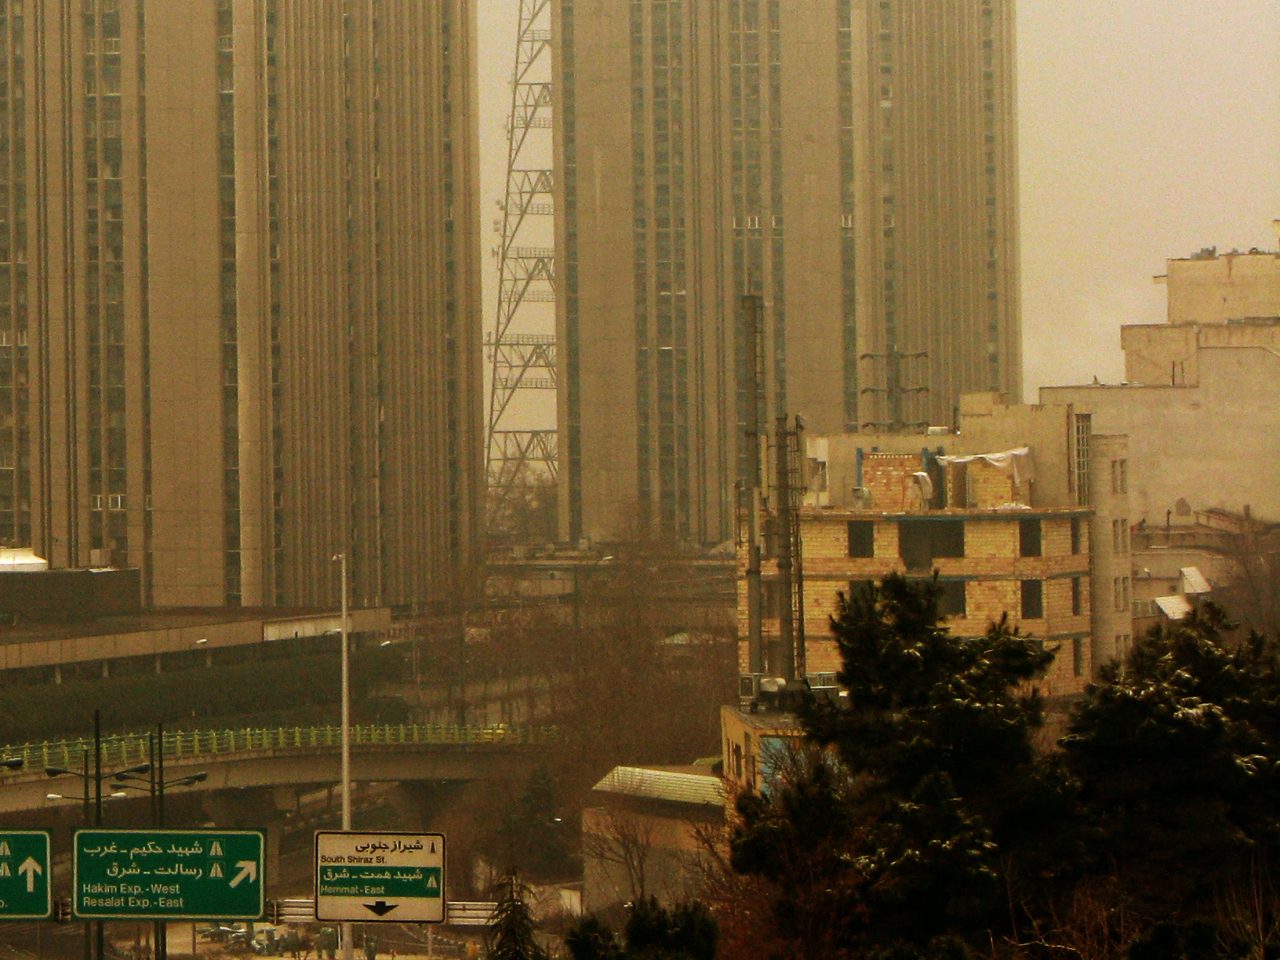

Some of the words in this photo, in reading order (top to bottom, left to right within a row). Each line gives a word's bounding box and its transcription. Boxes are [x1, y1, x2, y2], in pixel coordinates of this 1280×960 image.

[83, 842, 118, 857] غرب
[130, 841, 164, 859] حکیم
[167, 841, 203, 855] شهید
[355, 841, 389, 854] جنوبی
[390, 840, 423, 853] شیراز
[320, 855, 346, 863] South
[347, 855, 374, 864] Shiraz
[106, 862, 140, 878] شرق
[154, 864, 203, 880] رسالت
[323, 868, 350, 881] شرق
[360, 871, 392, 880] همت
[393, 869, 423, 882] شهید
[83, 883, 118, 894] Hakim
[320, 885, 359, 894] Hemmat
[83, 897, 125, 907] Resalat
